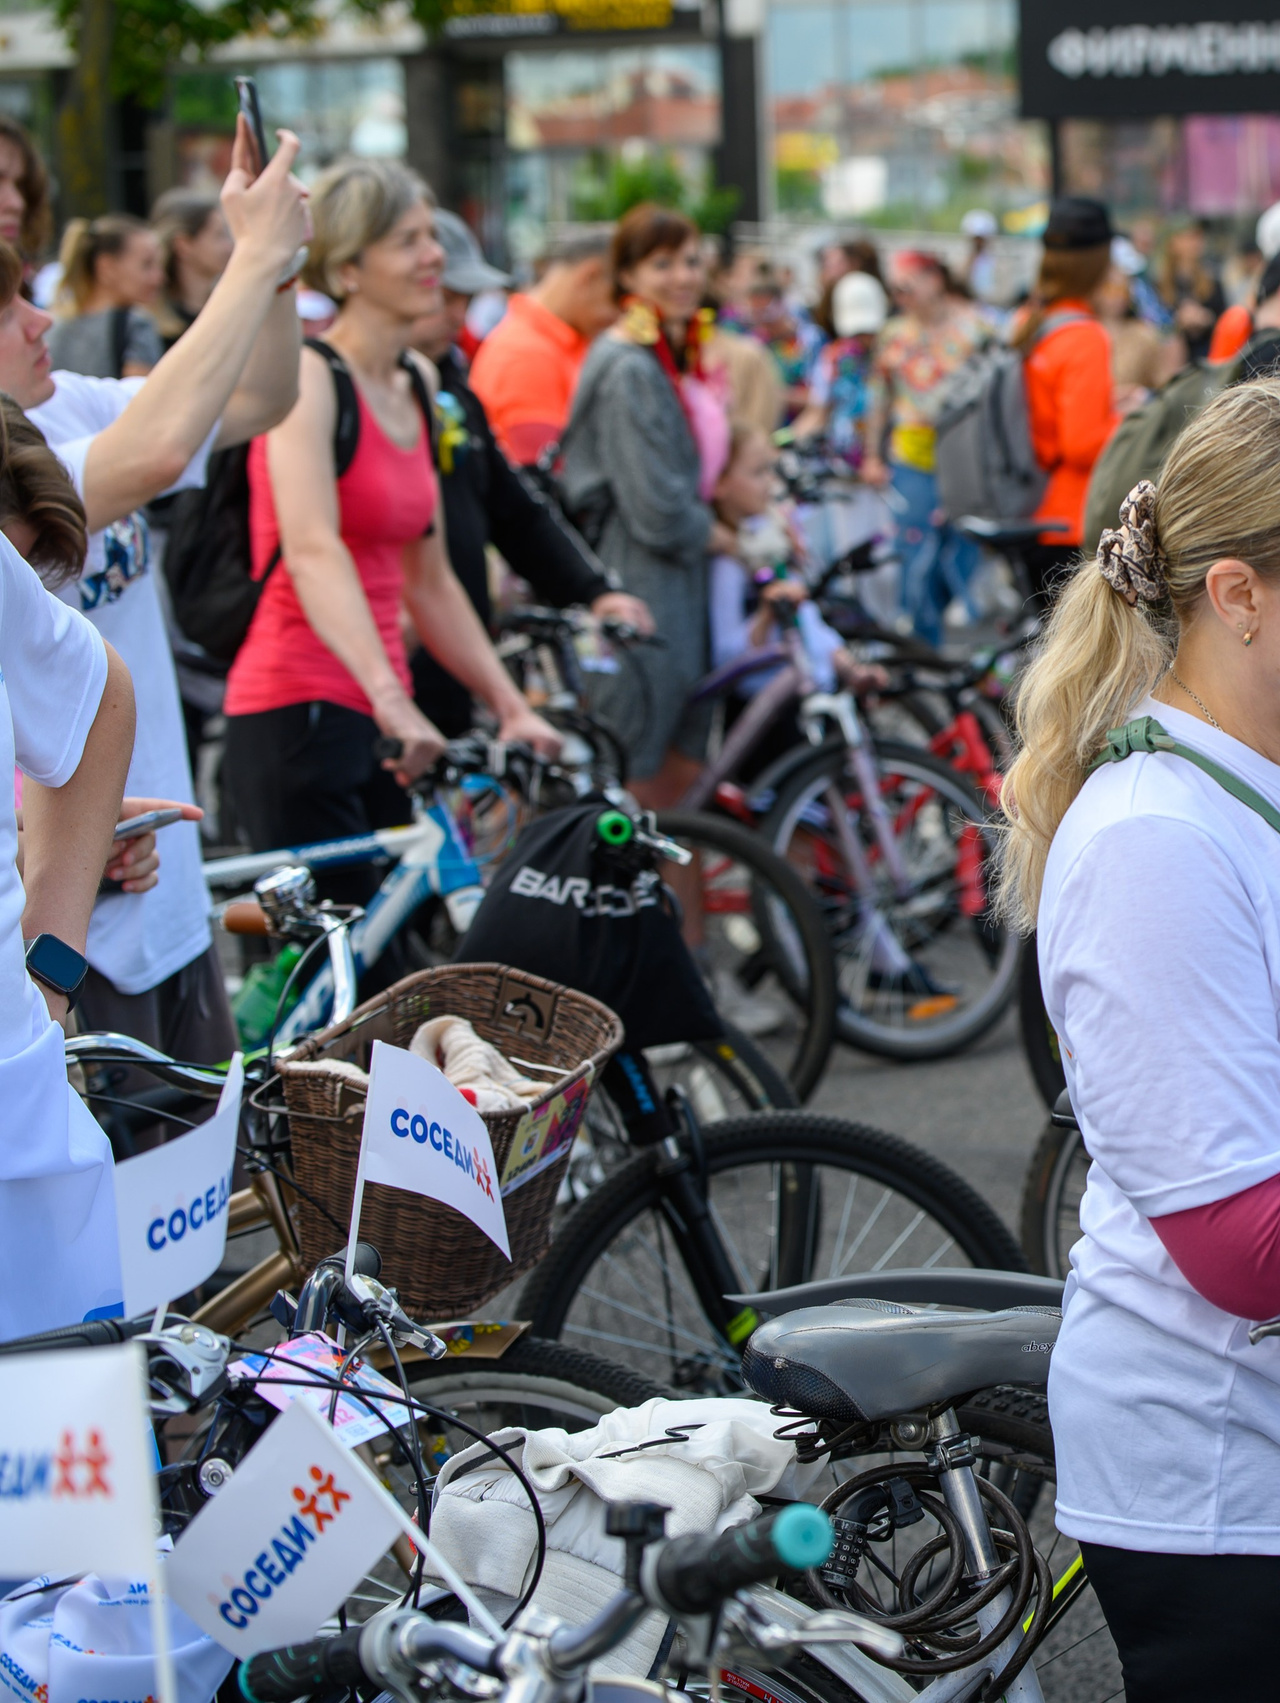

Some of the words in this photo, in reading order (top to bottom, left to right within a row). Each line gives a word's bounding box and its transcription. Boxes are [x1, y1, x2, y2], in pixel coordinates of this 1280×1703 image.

[390, 1108, 475, 1180] СОСЕДИ
[147, 1168, 232, 1250] СОСЕД
[219, 1515, 316, 1629] СОСЕДИ
